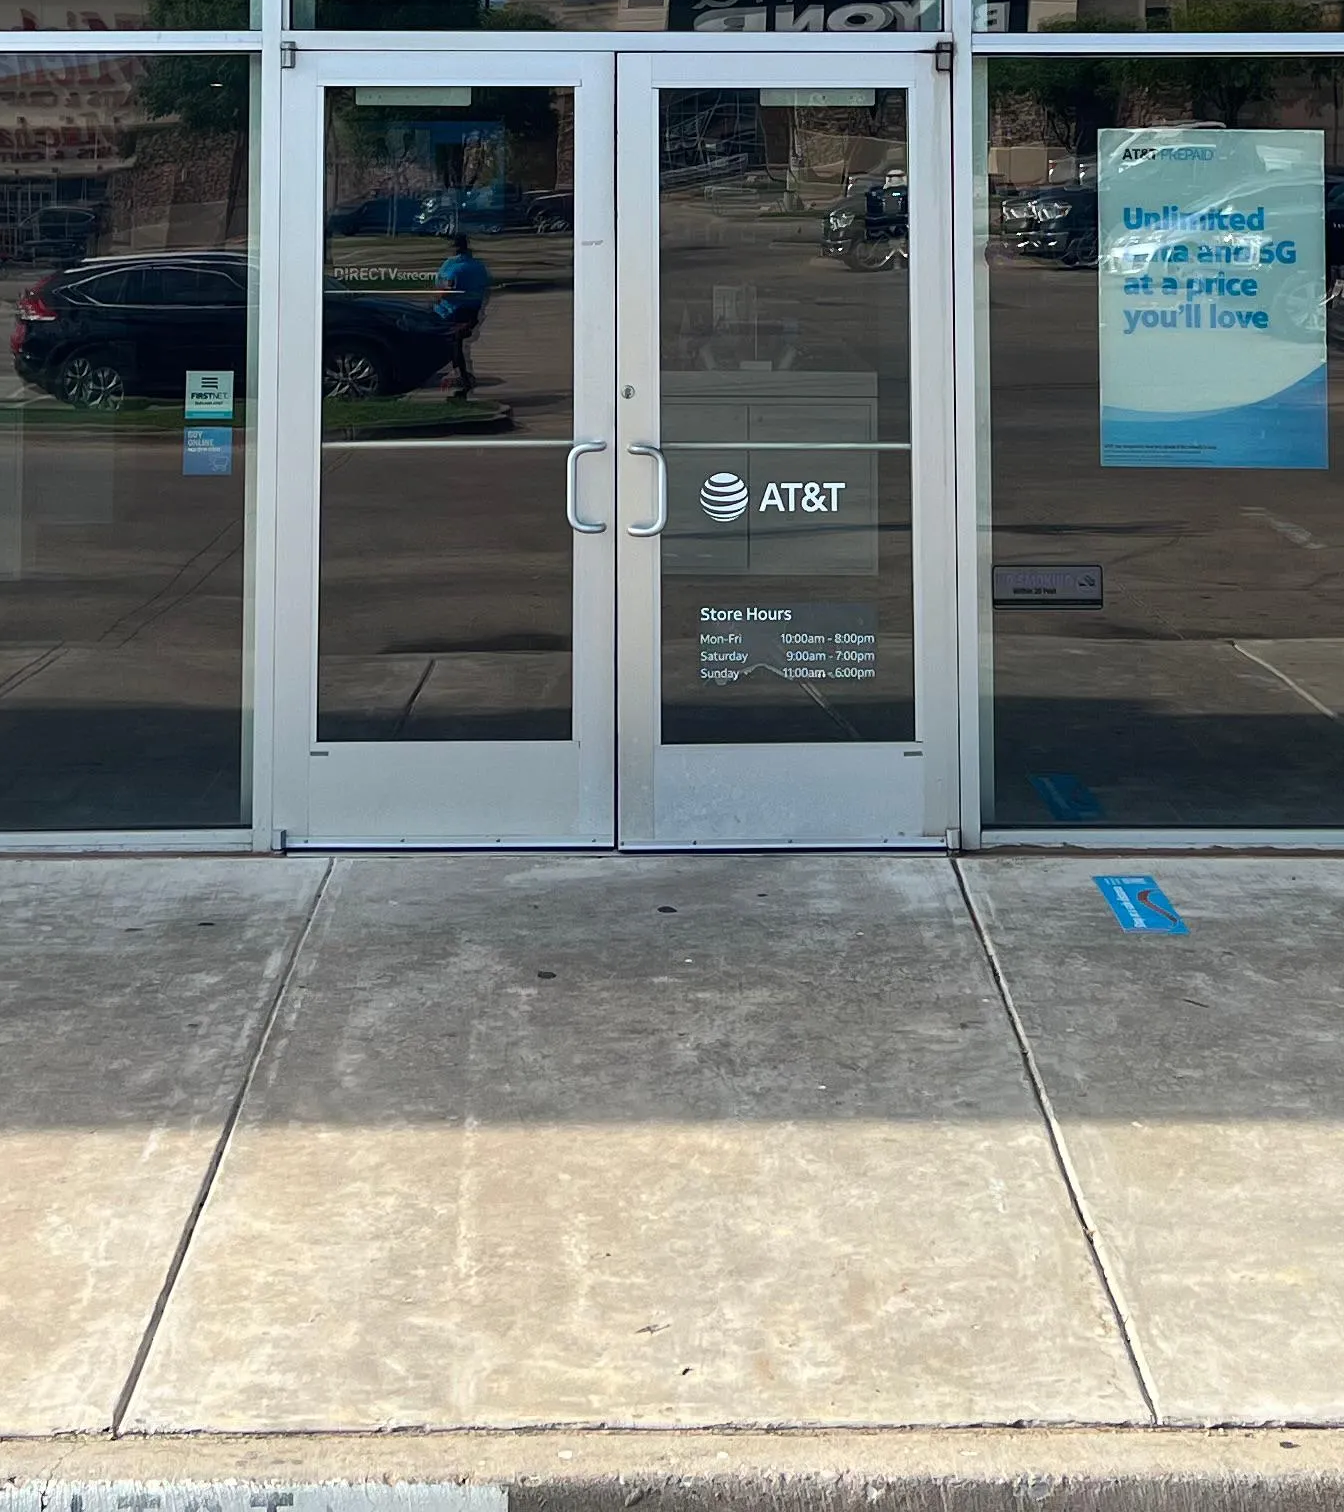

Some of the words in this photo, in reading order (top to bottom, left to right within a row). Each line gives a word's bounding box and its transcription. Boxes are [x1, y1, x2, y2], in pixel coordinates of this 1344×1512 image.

[1122, 148, 1157, 161] AT&T
[1161, 148, 1215, 161] PREPAID
[1123, 206, 1265, 231] Unlimited
[1259, 240, 1296, 264] 5G
[1123, 274, 1154, 295] at
[1162, 278, 1178, 295] a
[1187, 272, 1258, 302] price
[1210, 304, 1269, 329] love
[759, 482, 846, 512] AT&T
[700, 607, 743, 621] Store
[746, 607, 792, 621] Hours
[699, 633, 742, 645] Mon-Fri
[780, 633, 825, 644] 10:00am
[834, 633, 875, 646] 8:00pm
[700, 651, 748, 664] Saturday
[786, 651, 826, 661] 9:00am
[835, 651, 875, 664] 7:00pm
[700, 667, 740, 681] Sunday
[782, 667, 826, 679] 11:00am
[834, 667, 876, 681] 6:00pm
